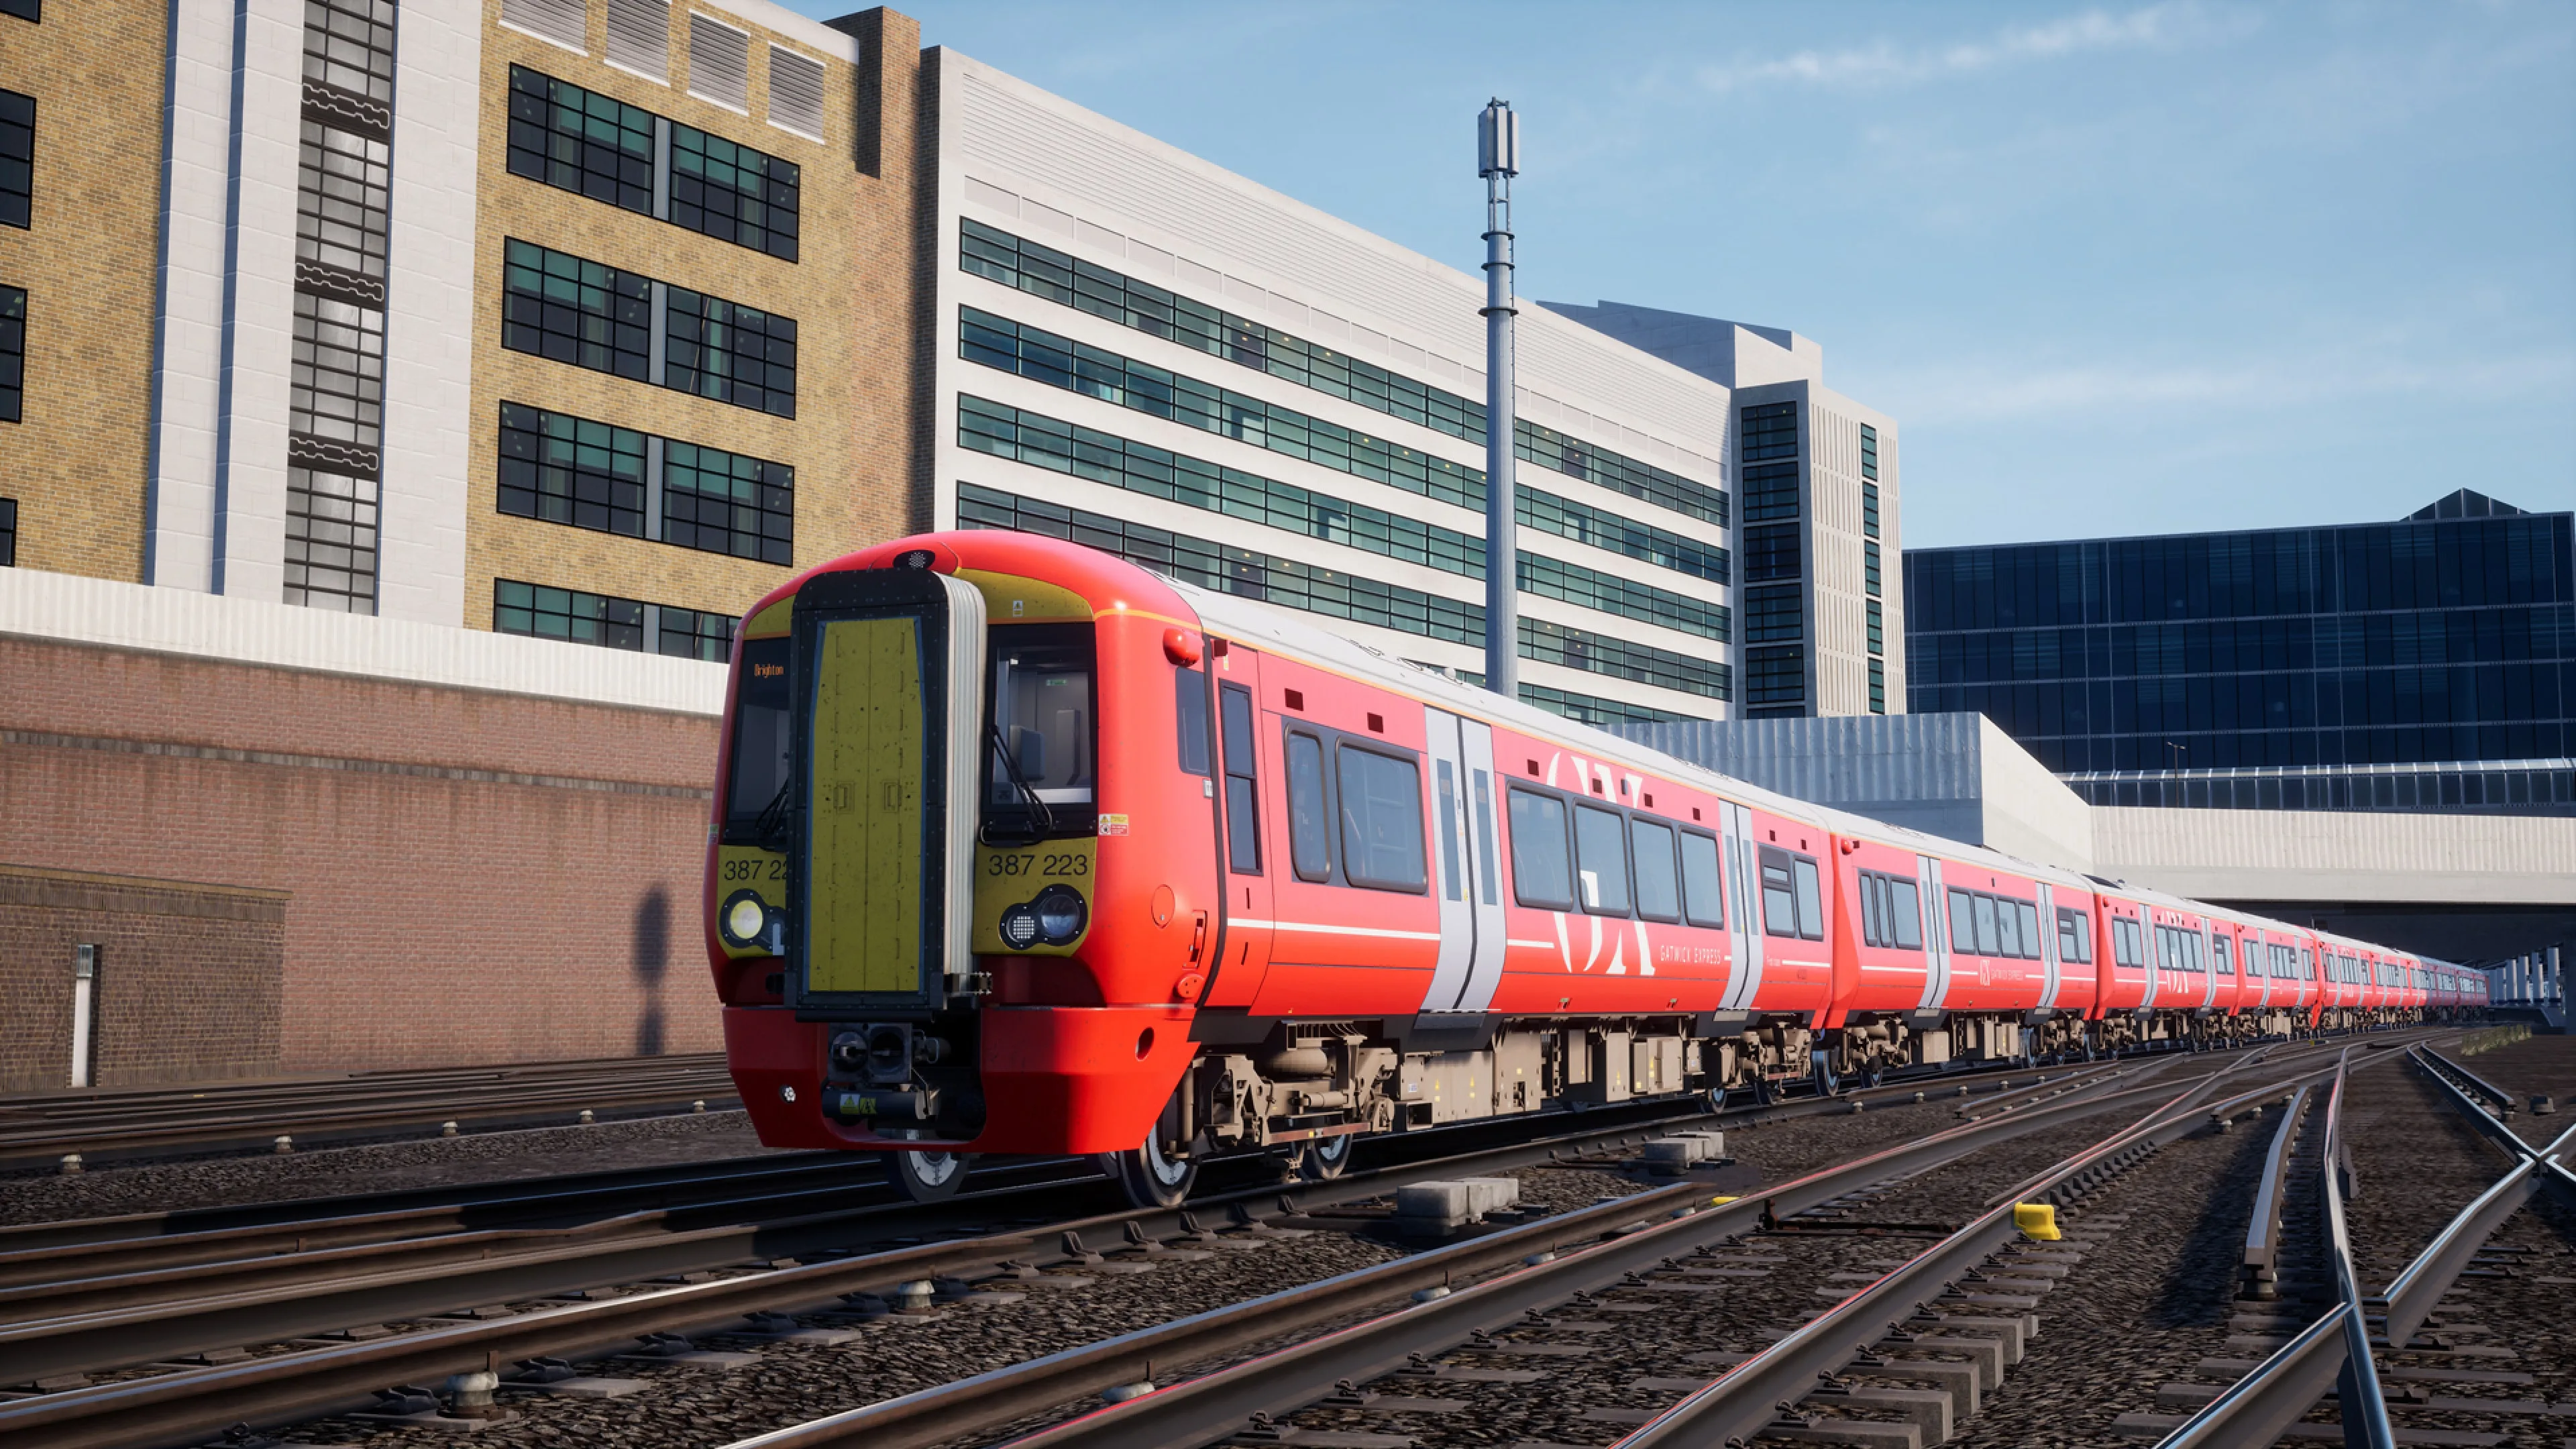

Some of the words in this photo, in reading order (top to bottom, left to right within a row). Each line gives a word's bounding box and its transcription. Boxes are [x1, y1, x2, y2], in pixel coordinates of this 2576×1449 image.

[754, 663, 784, 678] Brighton
[724, 860, 763, 880] 387
[989, 855, 1035, 875] 387
[1042, 855, 1087, 875] 223
[1661, 945, 1690, 962] GATWICK
[1695, 947, 1721, 964] EXPRESS
